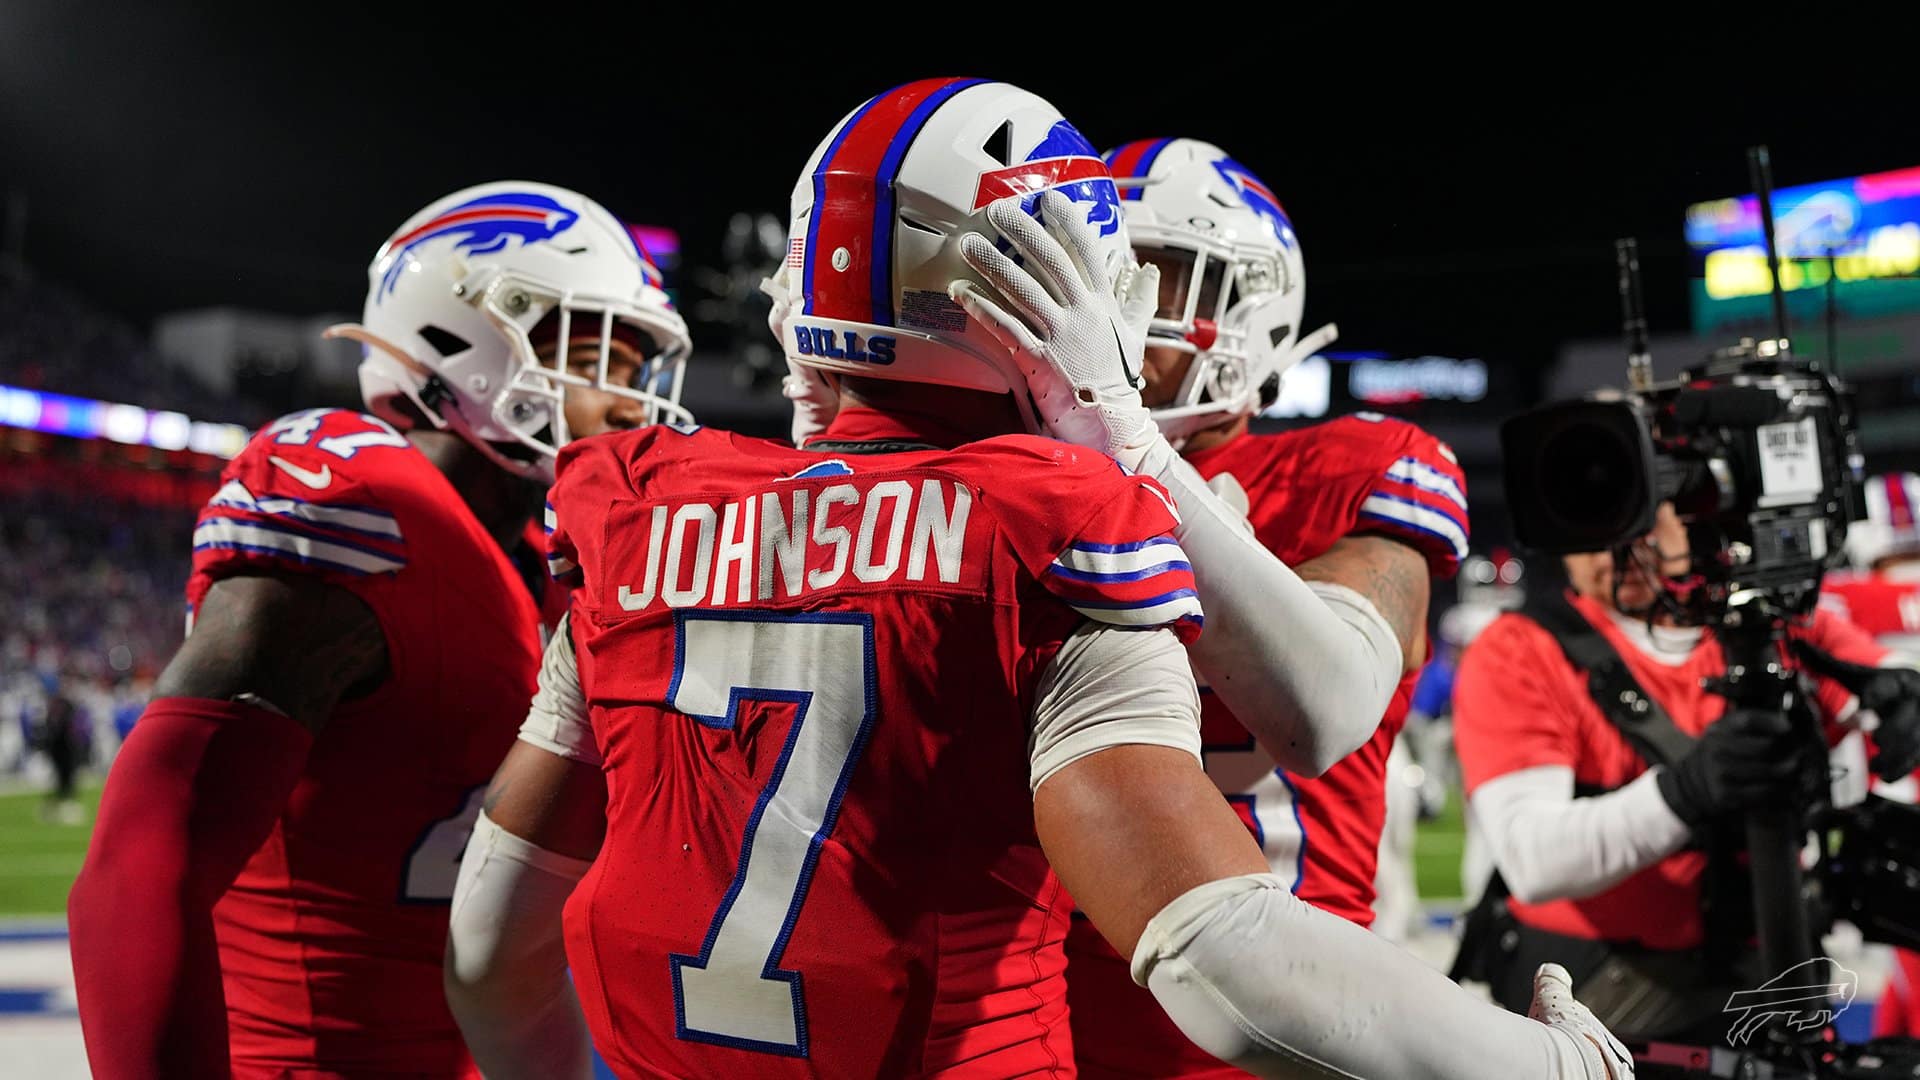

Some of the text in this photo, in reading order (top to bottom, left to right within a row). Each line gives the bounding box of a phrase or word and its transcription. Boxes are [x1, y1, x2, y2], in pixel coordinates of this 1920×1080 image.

[795, 325, 897, 365] BILLS
[265, 408, 411, 460] 47
[617, 479, 971, 611] JOHNSON
[666, 612, 877, 1057] 7
